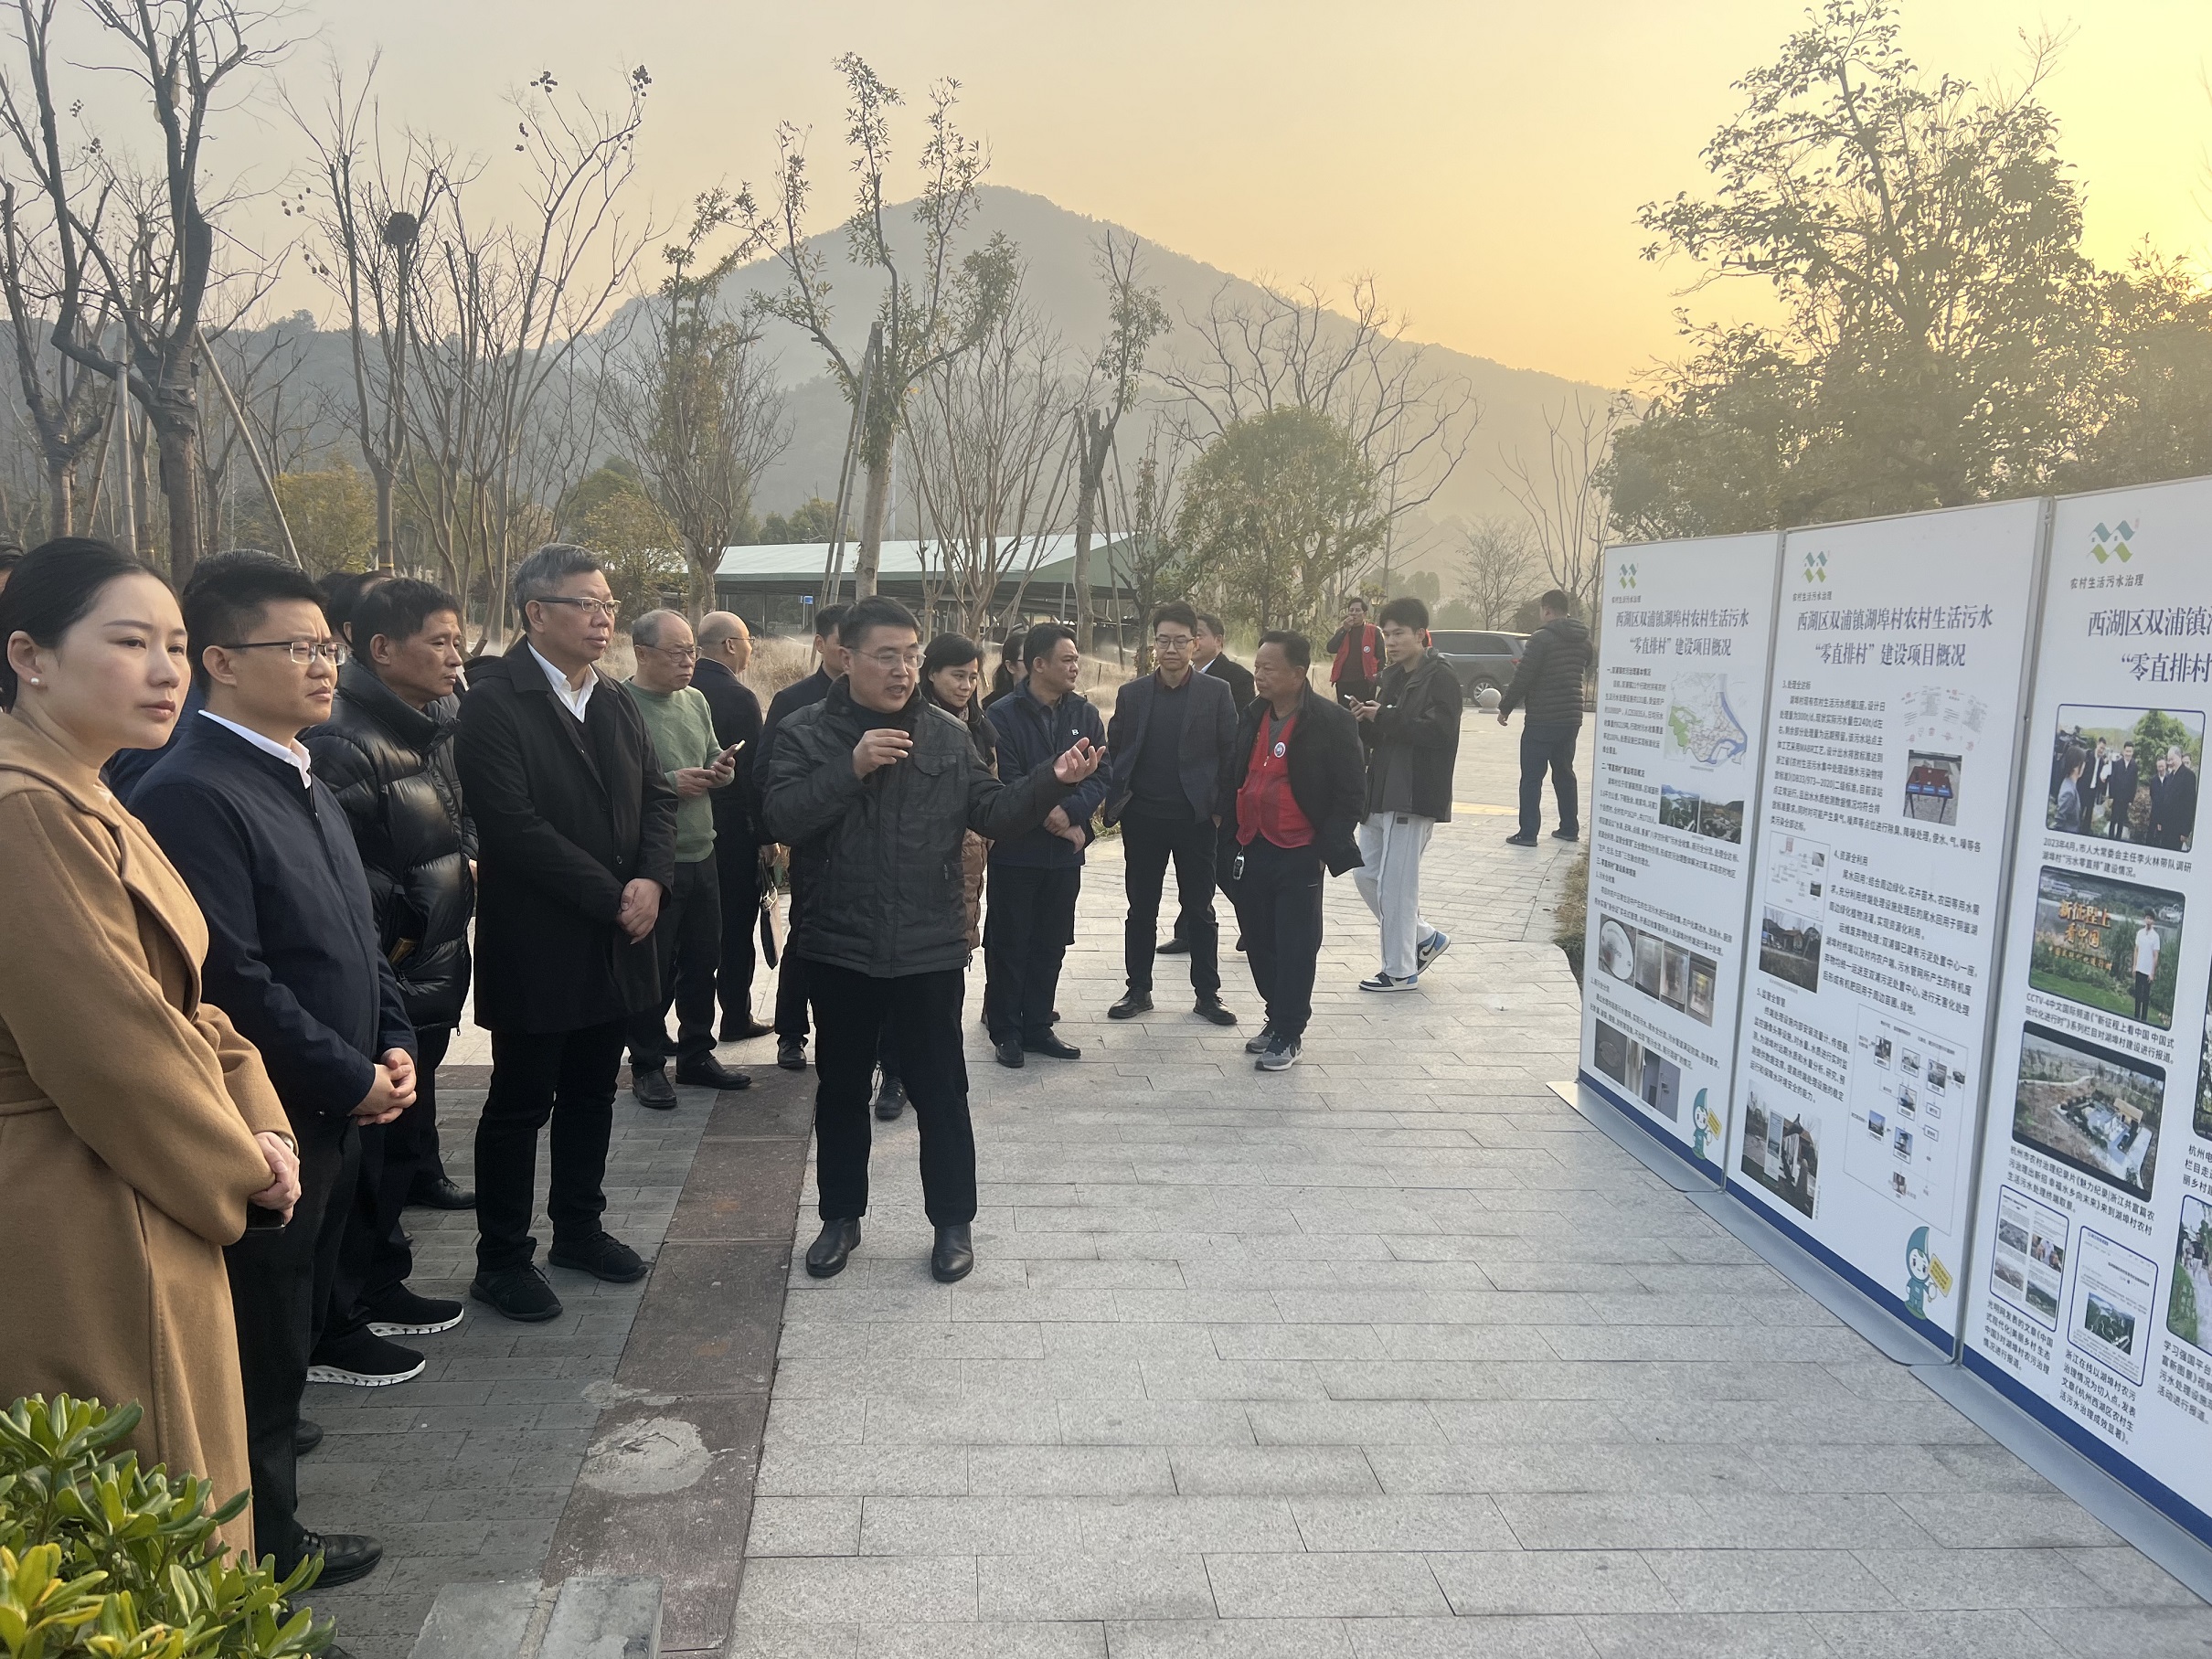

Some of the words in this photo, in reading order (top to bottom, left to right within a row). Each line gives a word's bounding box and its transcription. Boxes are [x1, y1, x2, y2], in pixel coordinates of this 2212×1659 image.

[2069, 573, 2144, 590] 农村生活污水治理
[1792, 590, 1833, 601] 农村生活污水治理
[1615, 608, 1749, 629] 西湖区双浦镇湖埠村农村生活污水
[1797, 603, 1994, 632] 西湖区双浦镇湖埠村农村生活污水
[2088, 605, 2212, 637] 西湖区双浦镇
[2188, 1144, 2212, 1164] 杭州电
